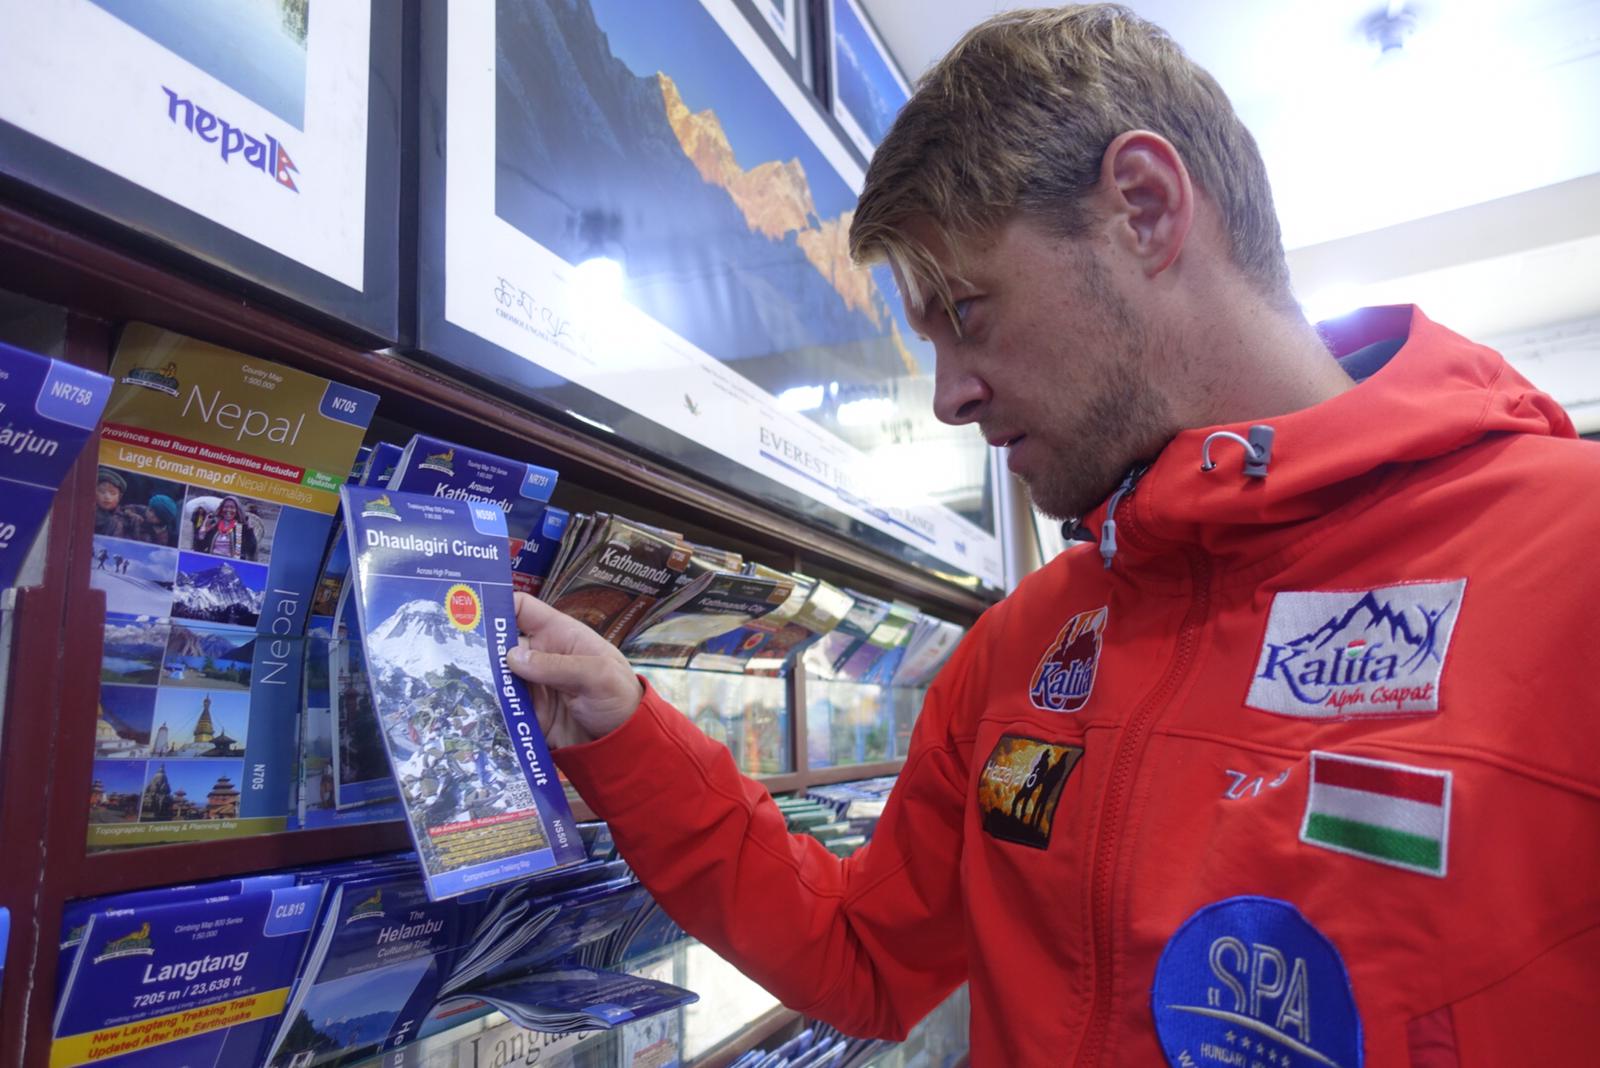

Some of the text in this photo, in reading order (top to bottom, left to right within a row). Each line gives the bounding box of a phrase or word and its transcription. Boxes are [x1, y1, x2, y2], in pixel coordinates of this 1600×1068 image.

[161, 84, 277, 180] nepal
[242, 364, 283, 382] Country Map
[50, 380, 93, 406] NR758
[331, 396, 358, 414] N705
[181, 384, 305, 446] Nepal
[101, 426, 300, 479] Provinces and Rural Municipalities included
[759, 427, 829, 478] EVEREST
[118, 447, 153, 468] Large
[155, 455, 194, 476] format
[195, 470, 222, 484] map
[223, 472, 238, 484] of
[236, 475, 268, 493] Nepal
[468, 481, 495, 494] Around
[366, 528, 449, 557] Dhaulagiri
[452, 539, 500, 561] Circuit
[588, 565, 614, 582] Patan
[613, 574, 620, 584] &
[598, 547, 672, 585] Kathmandu
[452, 595, 473, 606] NEW
[260, 588, 300, 686] Nepal
[1032, 659, 1091, 709] Kalifa
[1257, 642, 1398, 704] Kalifa
[494, 617, 548, 786] Dhaulagiri Circuit
[1370, 683, 1434, 710] Csapat
[252, 763, 266, 790] N705
[553, 819, 569, 849] NS501
[200, 922, 213, 931] Map
[226, 916, 244, 926] Series
[275, 902, 307, 918] CL819
[409, 911, 425, 921] The
[377, 919, 444, 945] Helambu
[377, 937, 433, 958] Cultural Trail
[142, 949, 249, 984] Langtang
[132, 990, 165, 1008] 7205
[167, 988, 180, 1001] m
[182, 984, 190, 999] /
[189, 978, 231, 997] 23,638
[231, 974, 243, 988] ft
[1208, 936, 1310, 1043] SPA
[88, 1011, 251, 1060] Updated After the Earthquake
[92, 997, 257, 1044] New Langtang Trekking Trails
